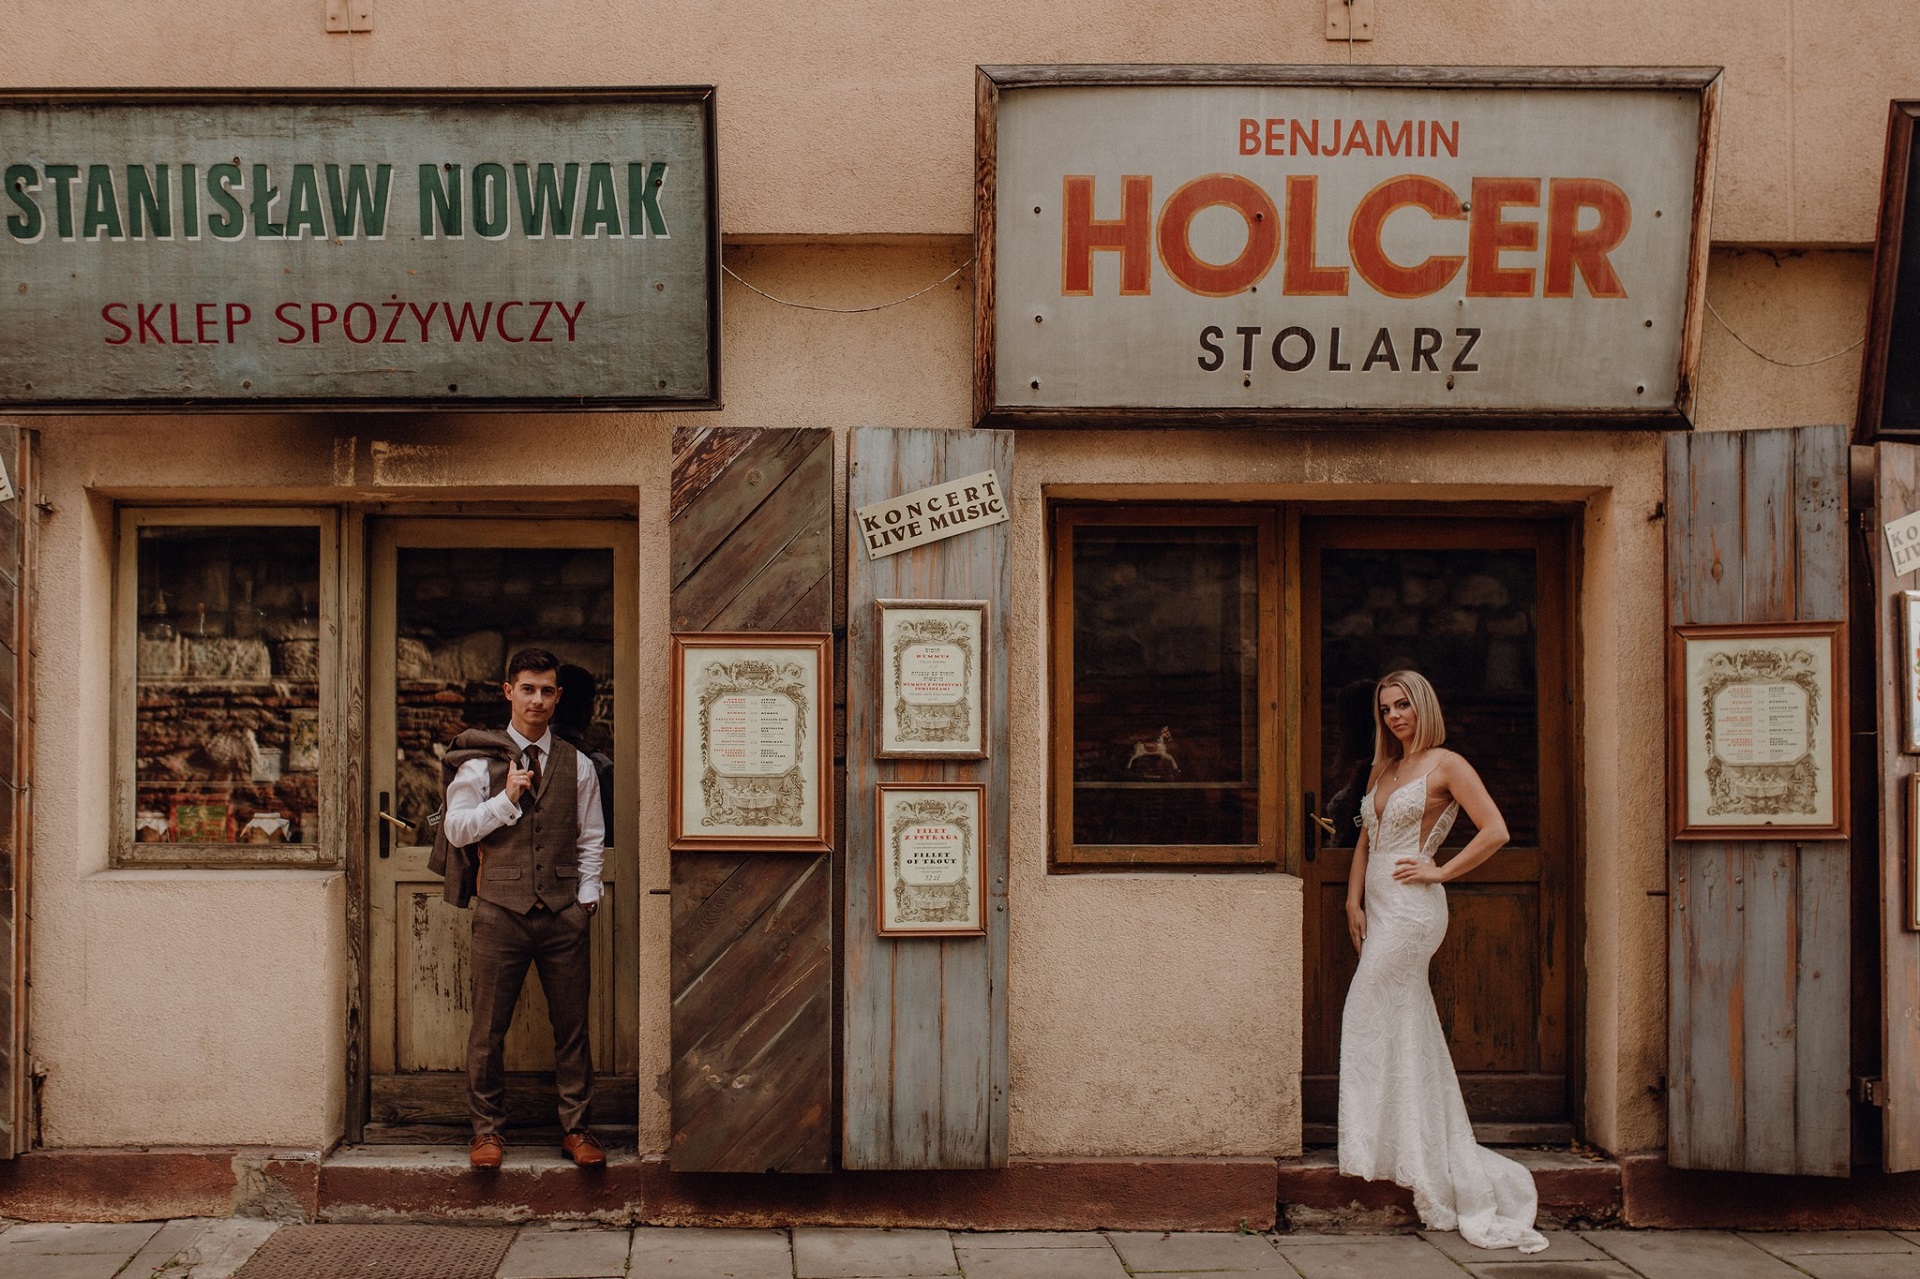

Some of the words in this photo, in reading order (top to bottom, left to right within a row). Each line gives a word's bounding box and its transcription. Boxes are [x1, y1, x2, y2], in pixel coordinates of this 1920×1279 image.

[1238, 117, 1460, 158] BENJAMIN
[4, 162, 395, 244] STANISŁAW
[419, 162, 671, 241] NOWAK
[1060, 172, 1633, 299] HOLCER
[101, 302, 252, 345] SKLEP
[276, 293, 587, 345] SPOŻYWCZY
[1197, 325, 1482, 373] STOLARZ
[862, 481, 995, 533] KONCERT
[867, 521, 923, 550] LIVE
[928, 498, 1003, 532] MUSIC
